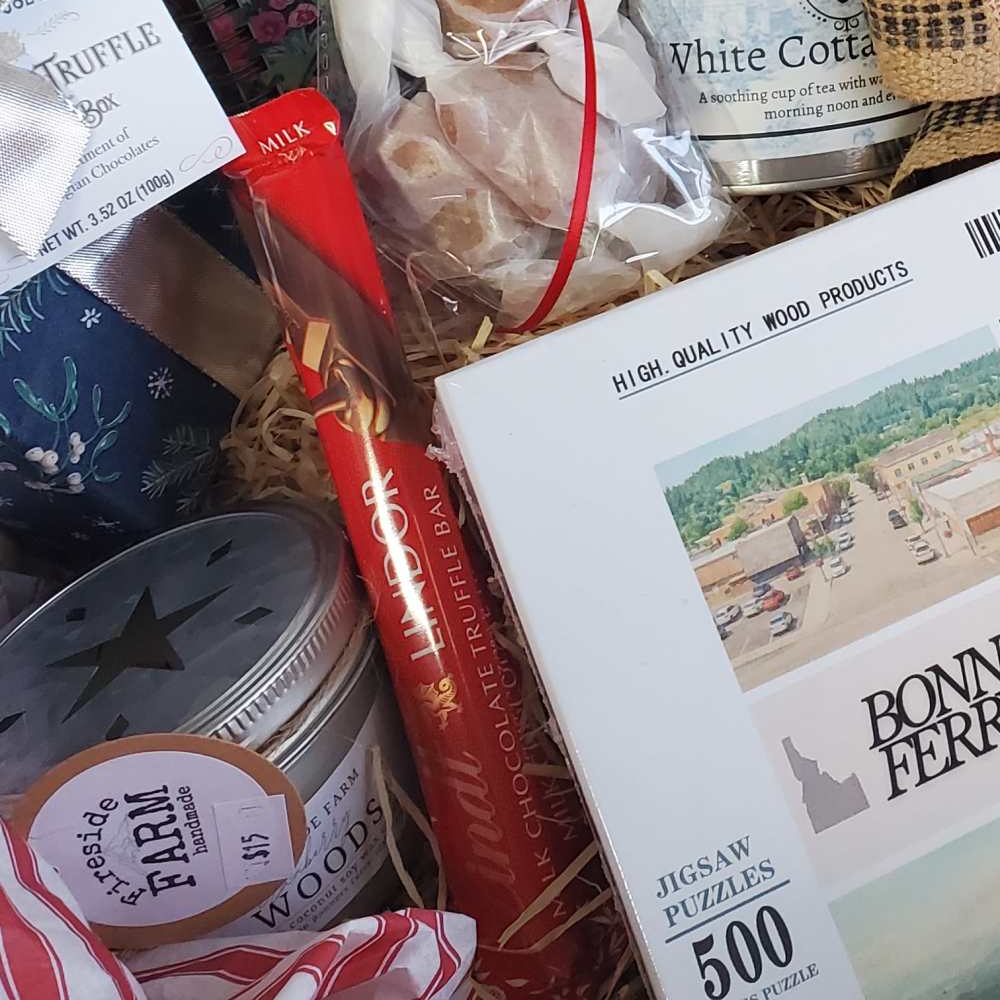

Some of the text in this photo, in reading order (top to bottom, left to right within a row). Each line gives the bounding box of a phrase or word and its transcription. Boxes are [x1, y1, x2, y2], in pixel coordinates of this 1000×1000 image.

[699, 91, 709, 104] A
[710, 89, 768, 105] soothing
[771, 87, 796, 101] cup
[799, 83, 815, 96] of
[816, 83, 836, 95] tea
[839, 76, 866, 91] with
[764, 103, 824, 120] morning
[826, 99, 859, 112] noon
[862, 90, 884, 107] and
[90, 136, 160, 178] Chocolates
[116, 126, 131, 144] of
[257, 120, 311, 155] MILK
[39, 168, 175, 257] NET WT. 3.52 OZ (100g)
[762, 300, 811, 332] WOOD
[818, 260, 909, 308] PRODUCTS
[423, 485, 451, 537] BAR
[440, 544, 488, 659] TRUFFLE
[478, 662, 543, 838] CHOCOLATE
[177, 785, 208, 856] handmade
[323, 767, 360, 816] FARM
[77, 797, 147, 906] Fireside
[124, 784, 197, 897] FARM
[252, 798, 384, 929] WOODS
[656, 835, 750, 899] JIGSAW
[534, 847, 568, 918] MLK
[662, 858, 775, 929] PUZZLES
[692, 905, 793, 1000] 500
[762, 963, 819, 1000] PUZZLE
